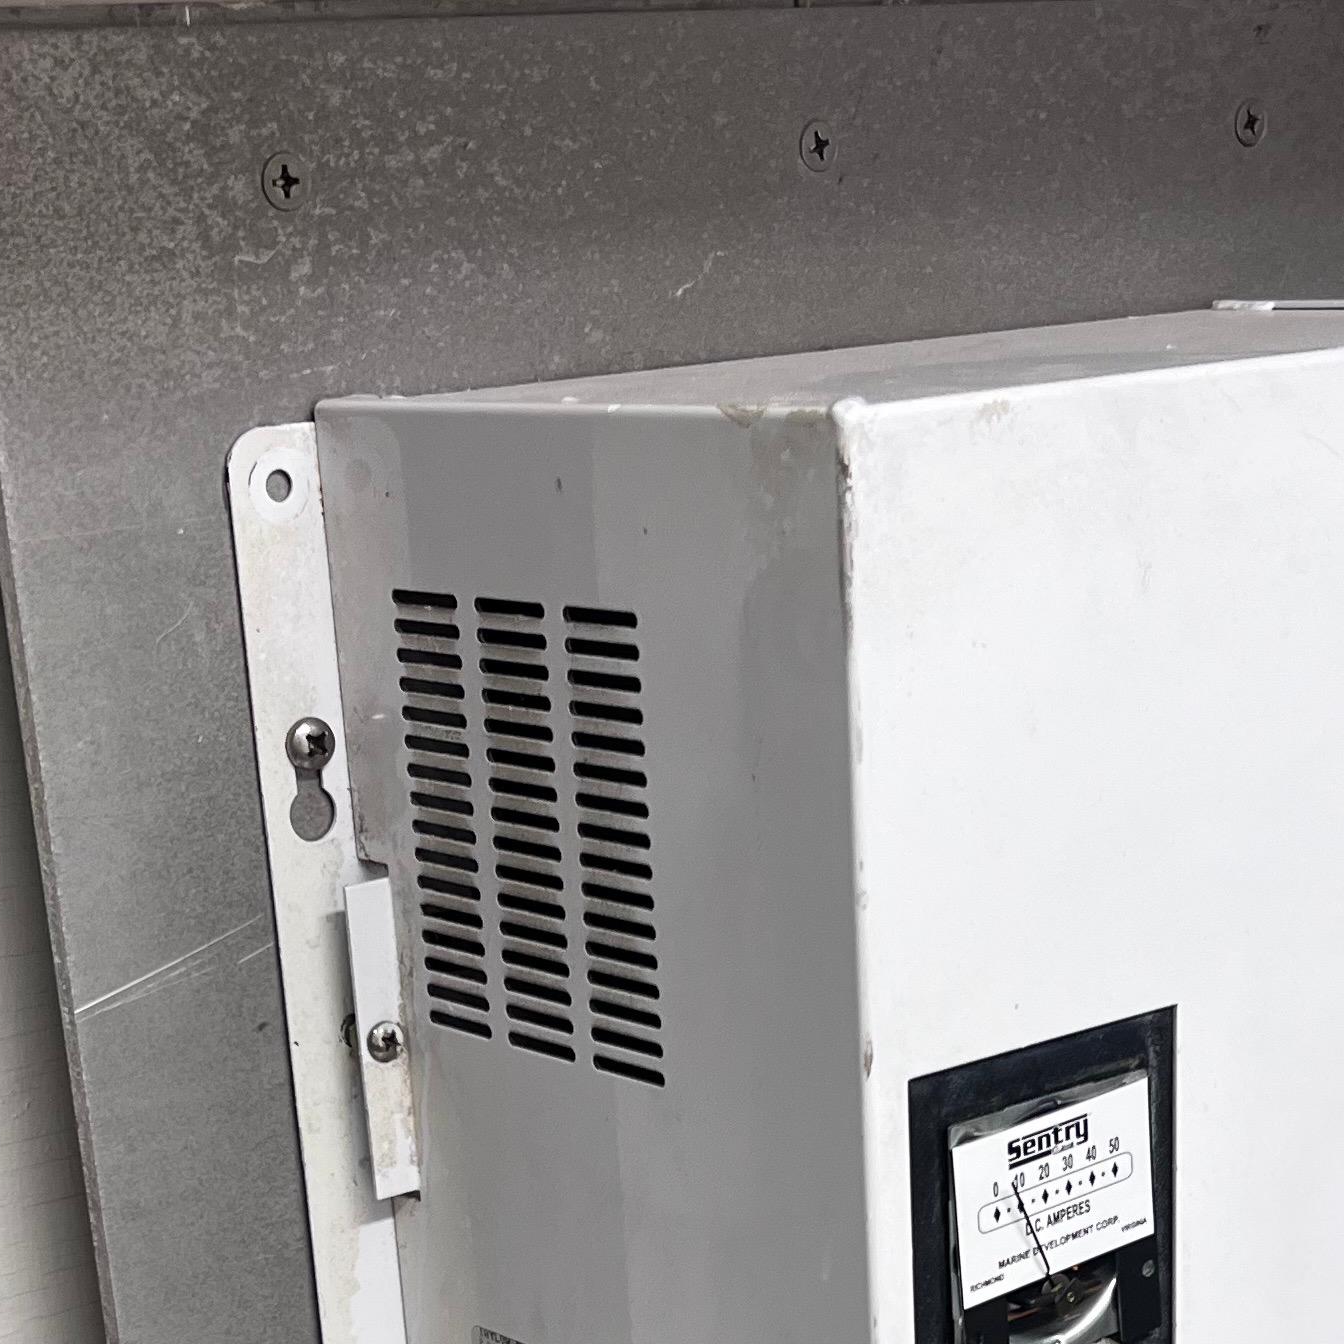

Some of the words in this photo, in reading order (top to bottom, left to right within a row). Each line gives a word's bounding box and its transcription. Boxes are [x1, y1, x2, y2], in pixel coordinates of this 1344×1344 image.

[1008, 1114, 1089, 1163] Sentry
[992, 1181, 1000, 1198] 0
[1038, 1162, 1051, 1181] 20
[1061, 1153, 1074, 1172] 30
[1085, 1144, 1097, 1162] 40
[1108, 1135, 1121, 1154] 50
[1046, 1199, 1091, 1228] AMPERES
[997, 1248, 1031, 1269] MARINE
[969, 1273, 1005, 1293] RICHMOND
